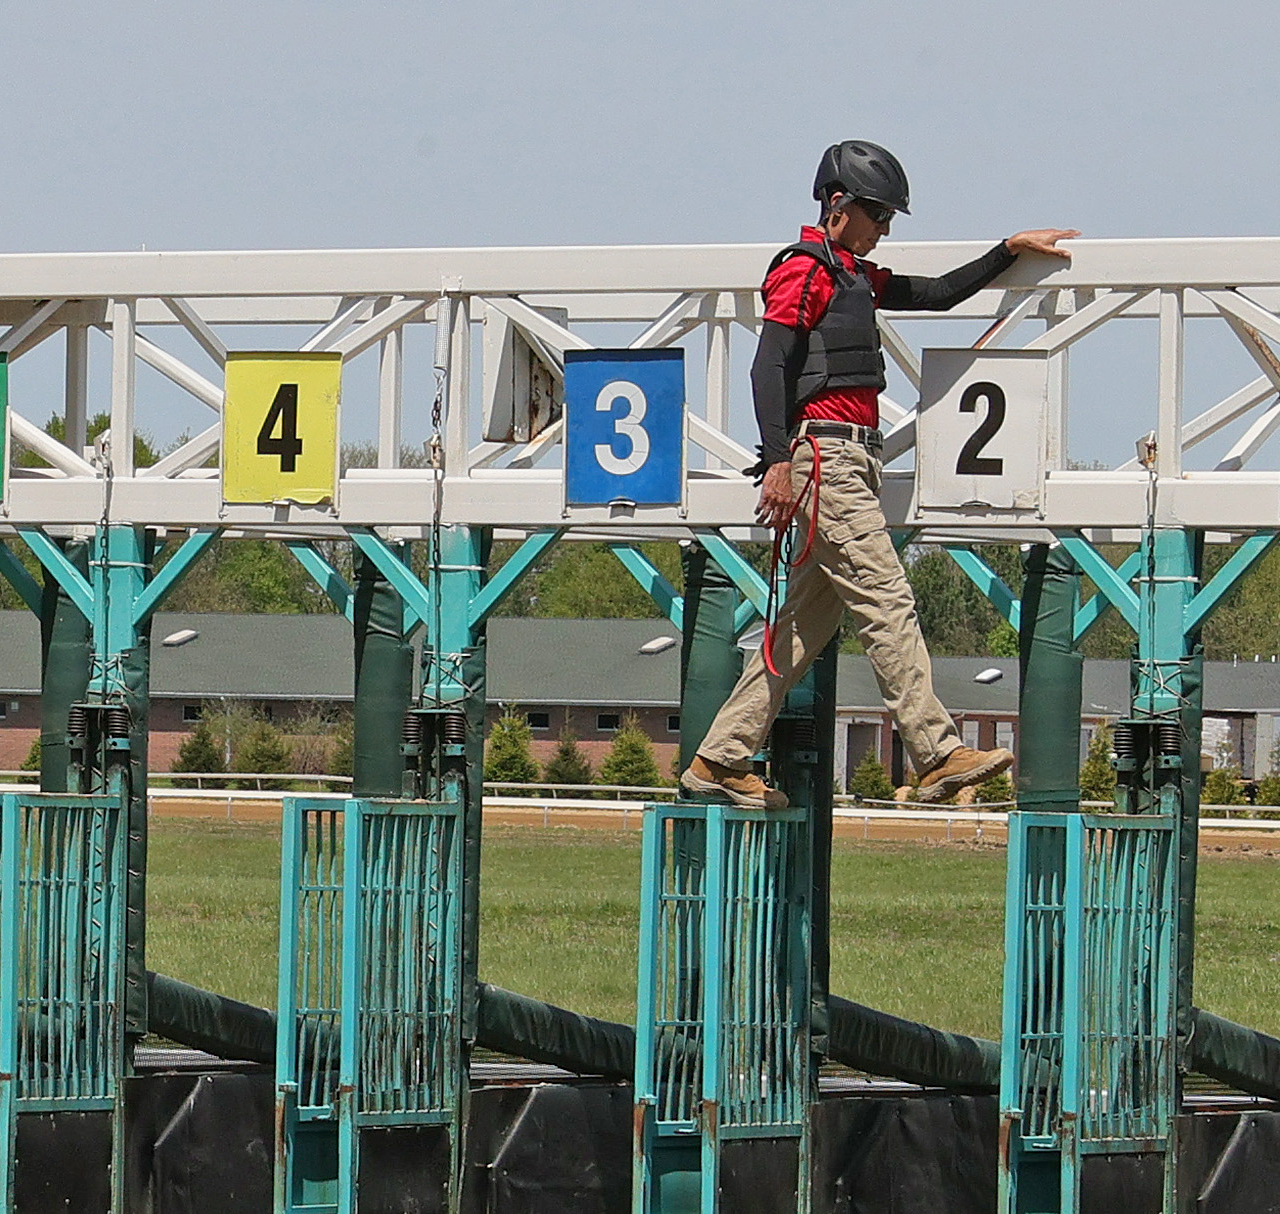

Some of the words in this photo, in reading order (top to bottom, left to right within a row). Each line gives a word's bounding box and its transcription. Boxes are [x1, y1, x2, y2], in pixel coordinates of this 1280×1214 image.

[256, 383, 303, 473] 4
[593, 380, 650, 475] 3
[955, 381, 1006, 476] 2
